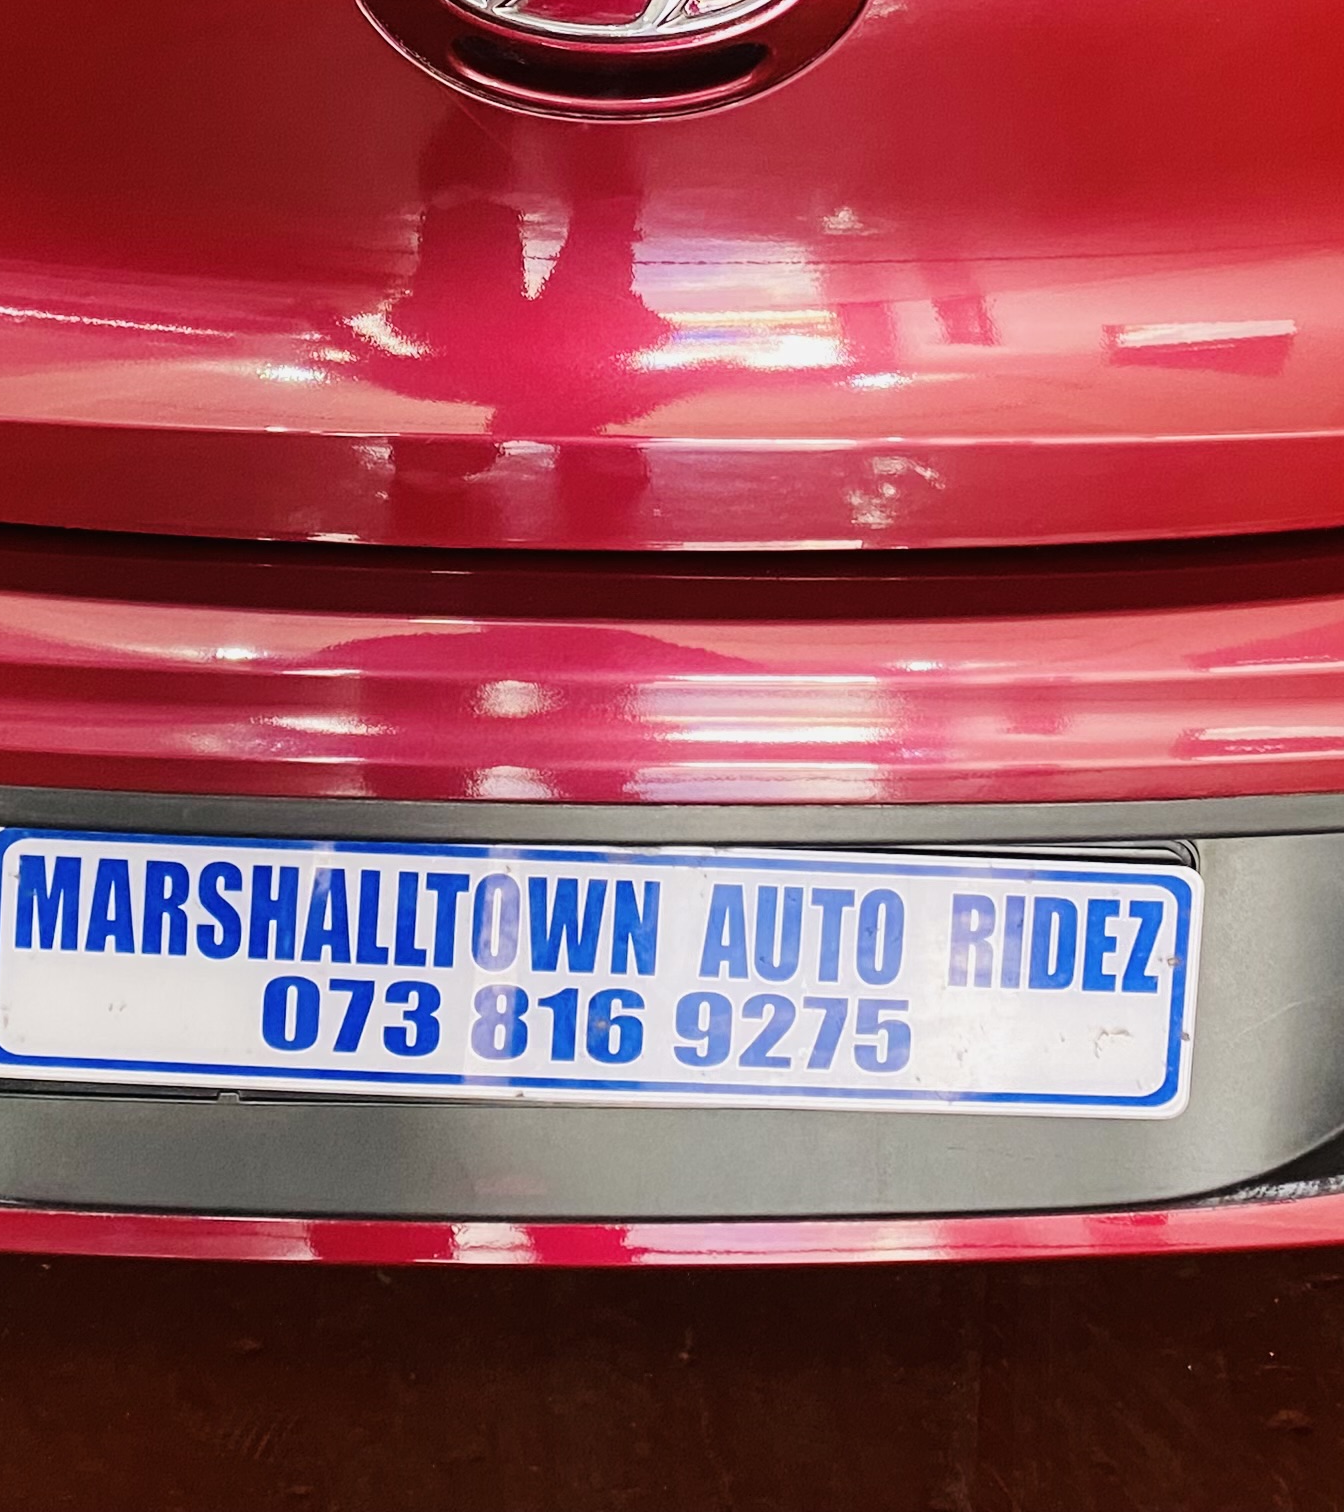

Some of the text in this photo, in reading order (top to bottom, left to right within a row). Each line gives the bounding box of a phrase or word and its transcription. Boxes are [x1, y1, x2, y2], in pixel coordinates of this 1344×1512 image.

[13, 853, 1166, 994] MARSHALLTOWN AUTO RIDEZ
[261, 974, 912, 1073] 073 816 9275
